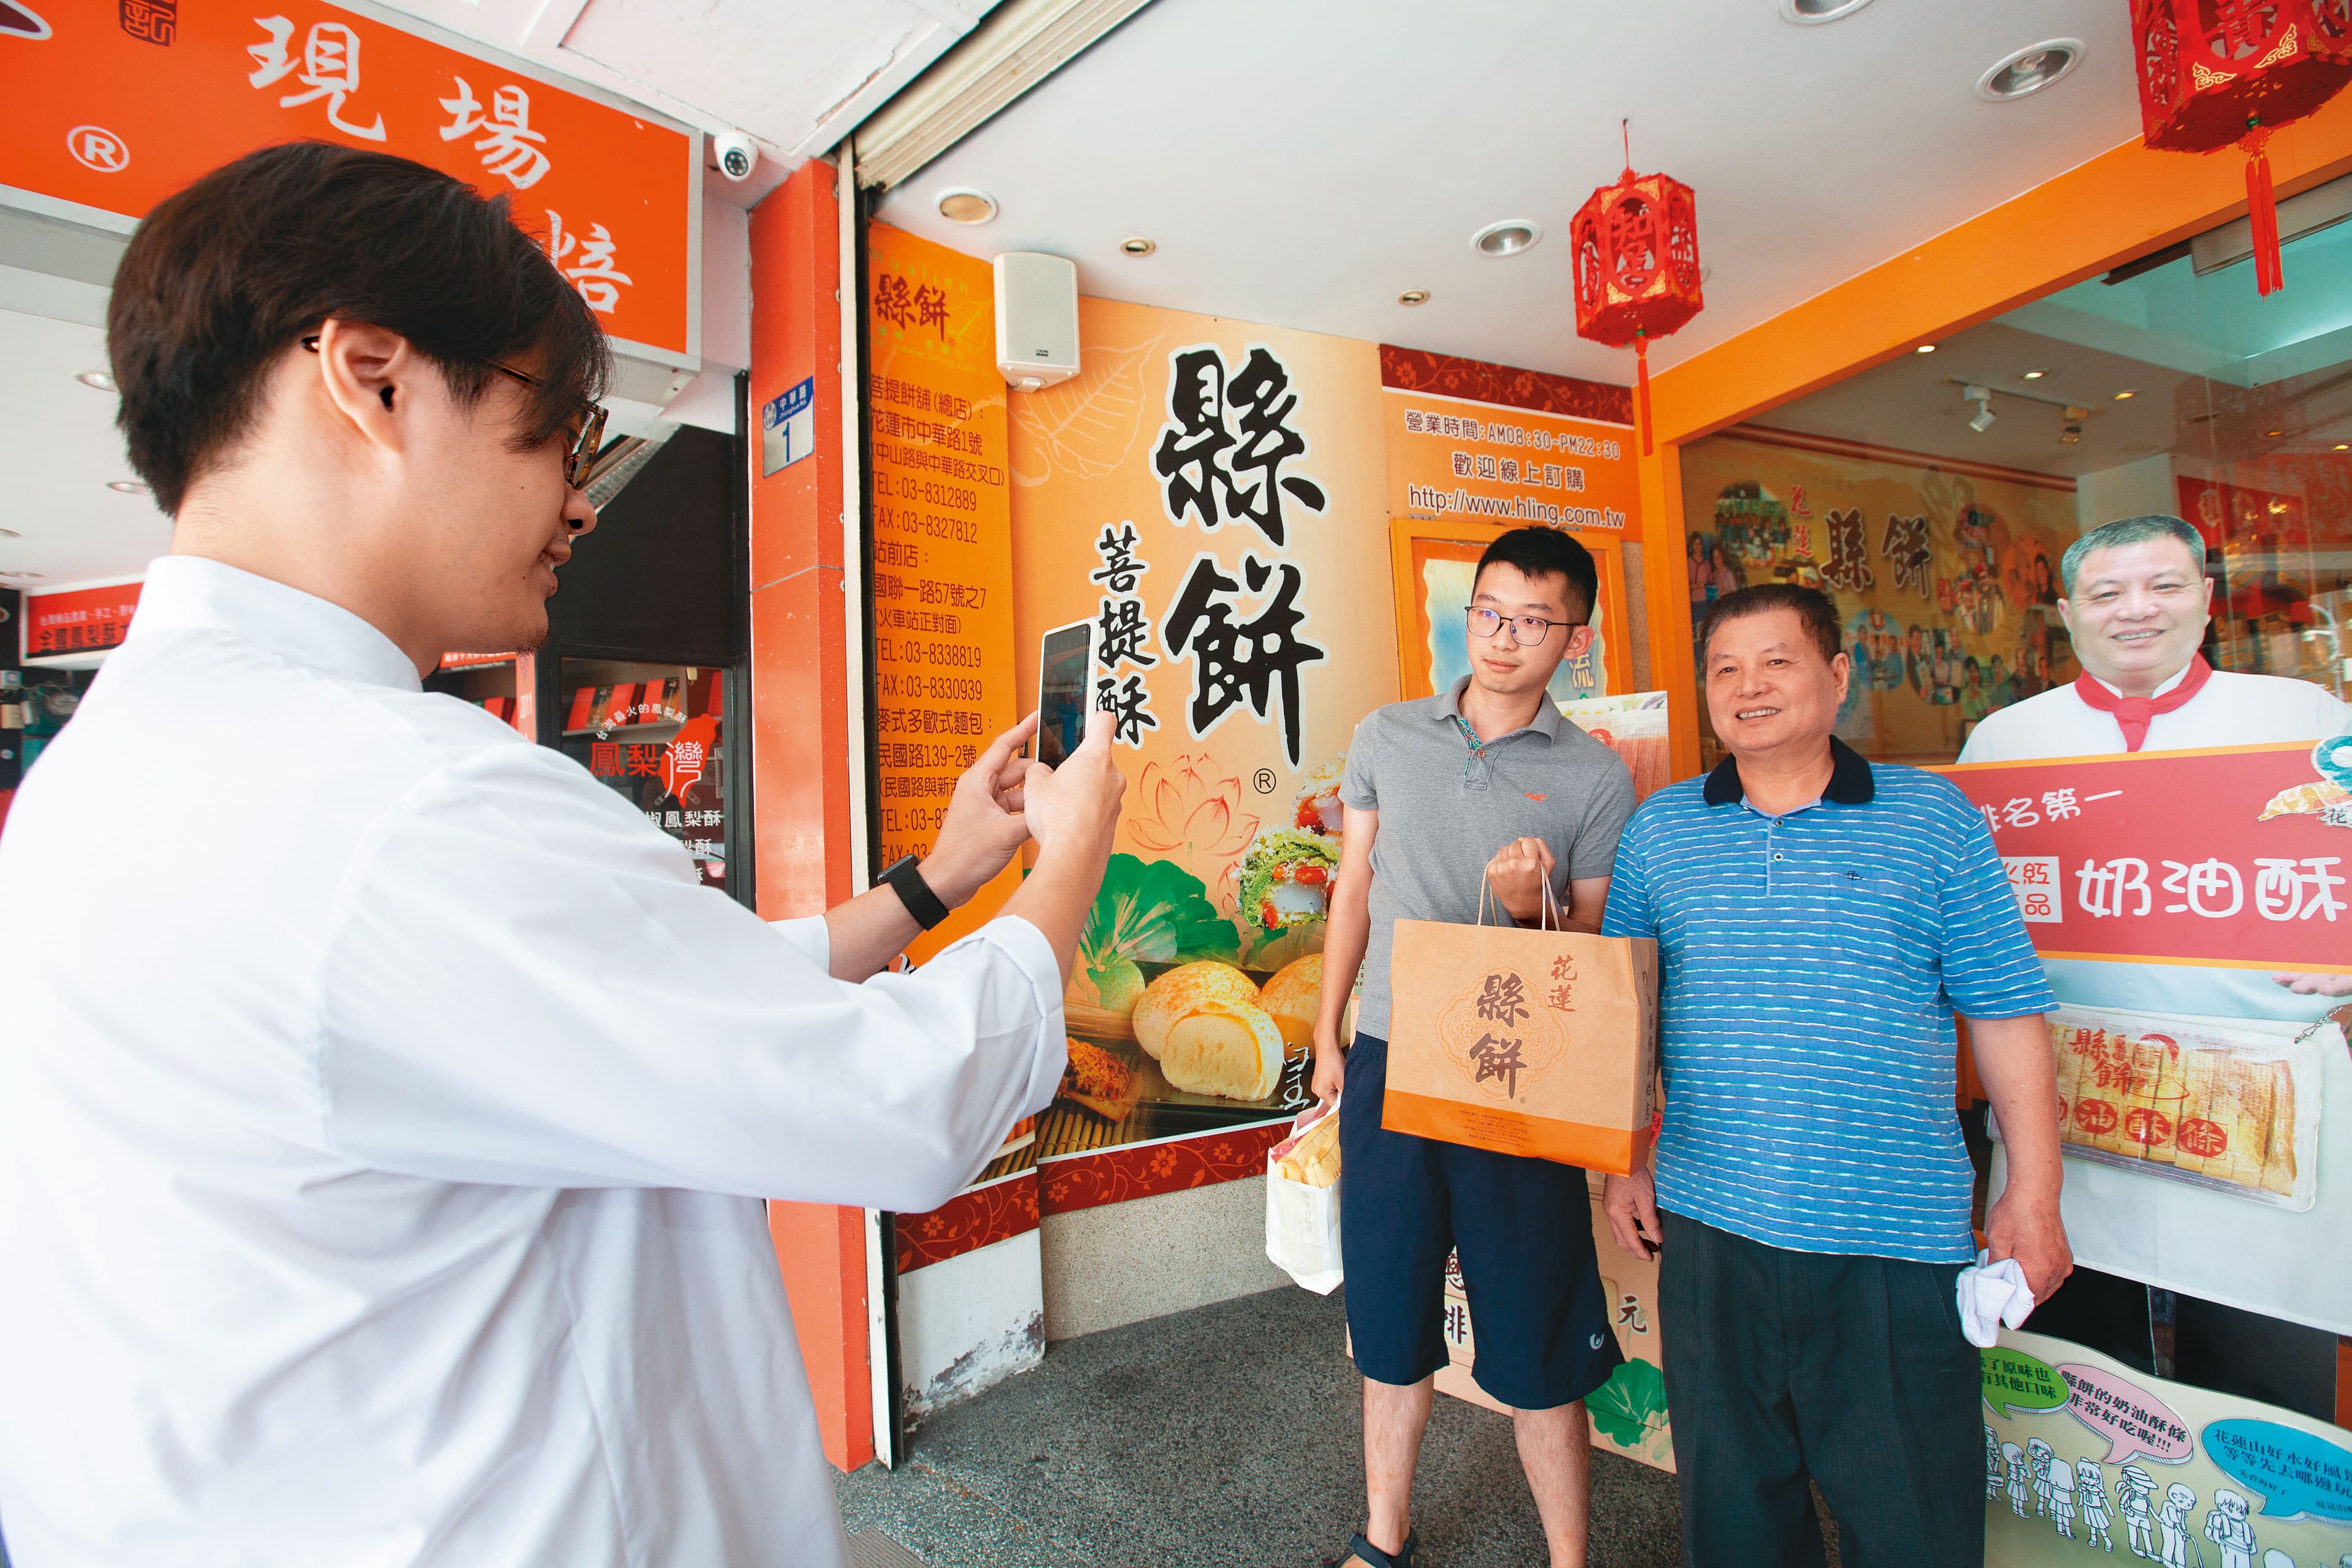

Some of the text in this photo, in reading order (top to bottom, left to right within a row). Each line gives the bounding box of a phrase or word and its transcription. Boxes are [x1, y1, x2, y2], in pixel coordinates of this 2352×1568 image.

[246, 15, 553, 189] 現場
[875, 274, 951, 342] 縣餅
[782, 421, 790, 462] 1
[872, 409, 982, 456] 花蓮市中華路1號
[1453, 453, 1585, 491] 歡迎線上訂購
[1409, 484, 1625, 528] http://www.hling.com.tw
[1153, 346, 1327, 769] 縣餅
[874, 575, 987, 609] 國聯一路57號之7
[596, 703, 687, 741] 台灣最火的鳳梨酥
[2326, 807, 2352, 825] 花
[2075, 857, 2348, 922] 奶油酥
[1547, 954, 1578, 1012] 花蓮
[1469, 973, 1529, 1099] 縣餅
[2068, 1028, 2132, 1097] 縣餅
[2059, 1102, 2225, 1155] 油酥條
[1618, 1294, 1648, 1333] 元
[2061, 1370, 2187, 1443] 縣餅的奶油酥條
[2070, 1392, 2171, 1453] 非常好吃喔!!!
